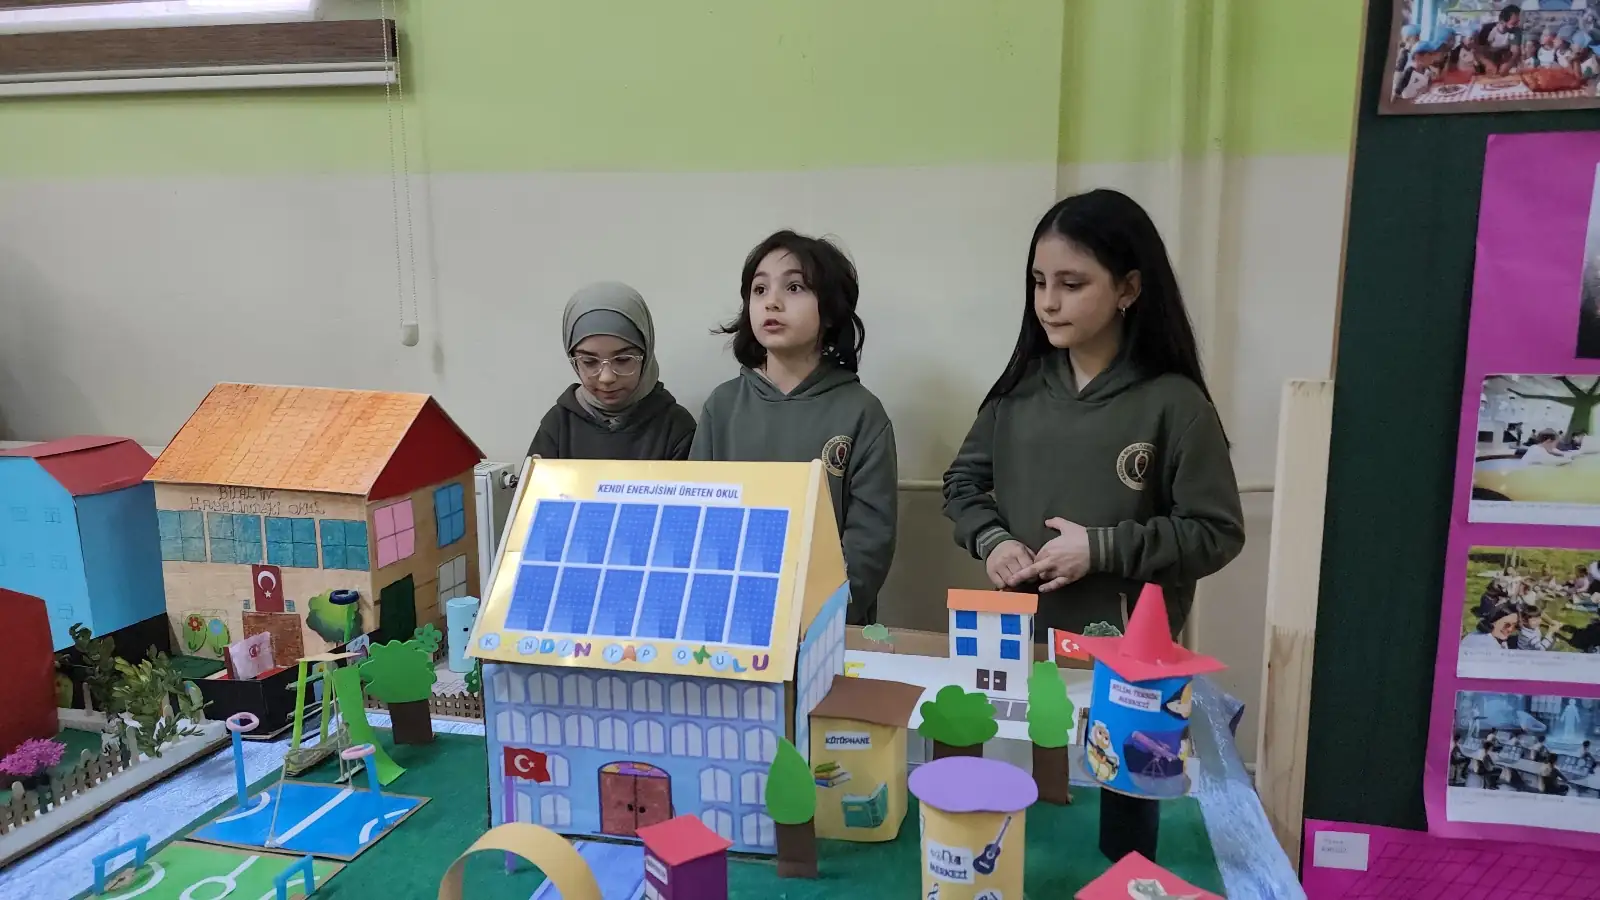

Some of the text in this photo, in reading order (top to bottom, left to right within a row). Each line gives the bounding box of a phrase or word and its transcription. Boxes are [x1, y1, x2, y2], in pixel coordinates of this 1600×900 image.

[598, 484, 739, 499] KENDİ ENERJİSİNİ ÜRETEN OKUL
[825, 736, 870, 744] KÜTÜPHANE
